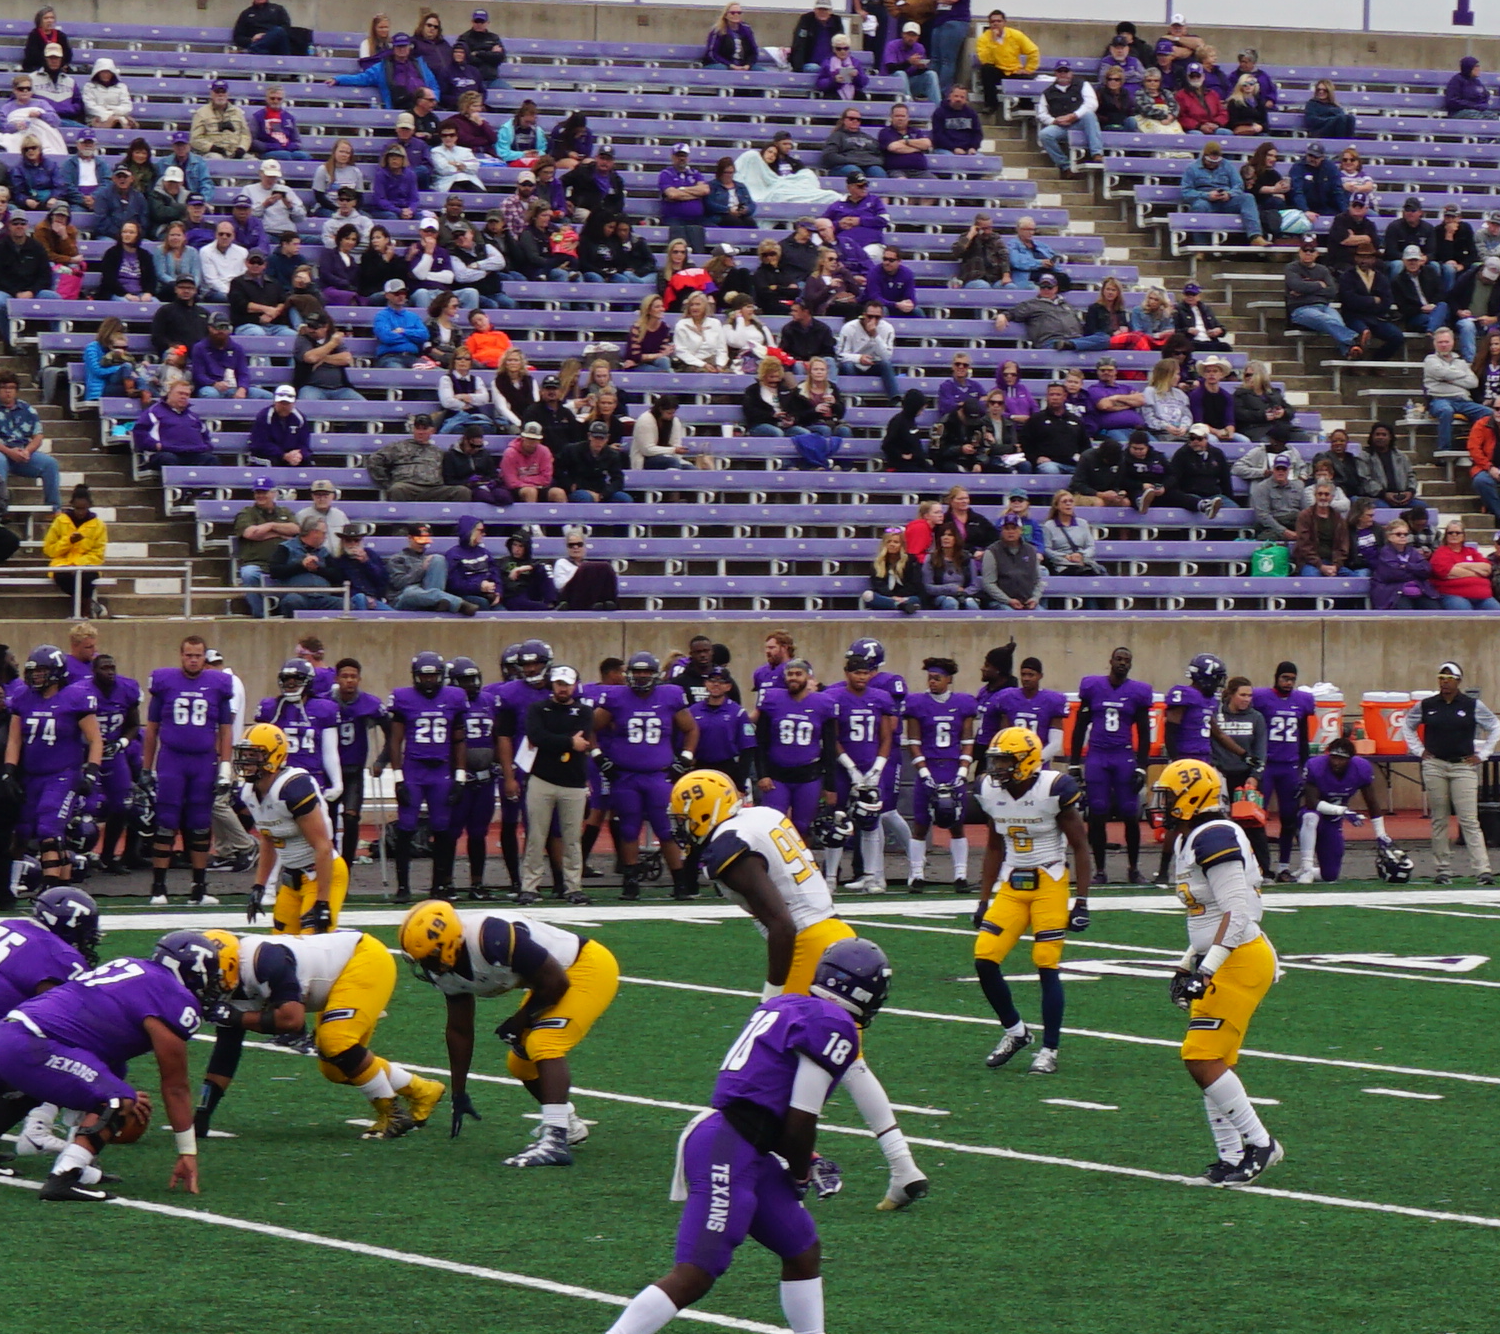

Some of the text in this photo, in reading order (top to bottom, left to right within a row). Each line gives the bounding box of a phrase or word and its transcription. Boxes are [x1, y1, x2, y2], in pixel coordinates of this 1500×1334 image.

[173, 698, 208, 726] 68
[1105, 709, 1119, 732] 8
[1321, 712, 1339, 733] G
[25, 718, 57, 746] 74
[414, 717, 448, 744] 26
[627, 717, 663, 745] 66
[850, 715, 875, 743] 51
[935, 721, 952, 748] 6
[1024, 735, 1034, 747] 6
[1270, 717, 1299, 742] 22
[1178, 768, 1203, 785] 33
[1008, 825, 1034, 853] 6
[66, 900, 90, 927] T
[190, 943, 213, 973] T
[719, 1010, 780, 1072] 18
[821, 1032, 853, 1066] 18
[45, 1054, 99, 1083] TEXANS
[706, 1164, 731, 1234] TEXANS
